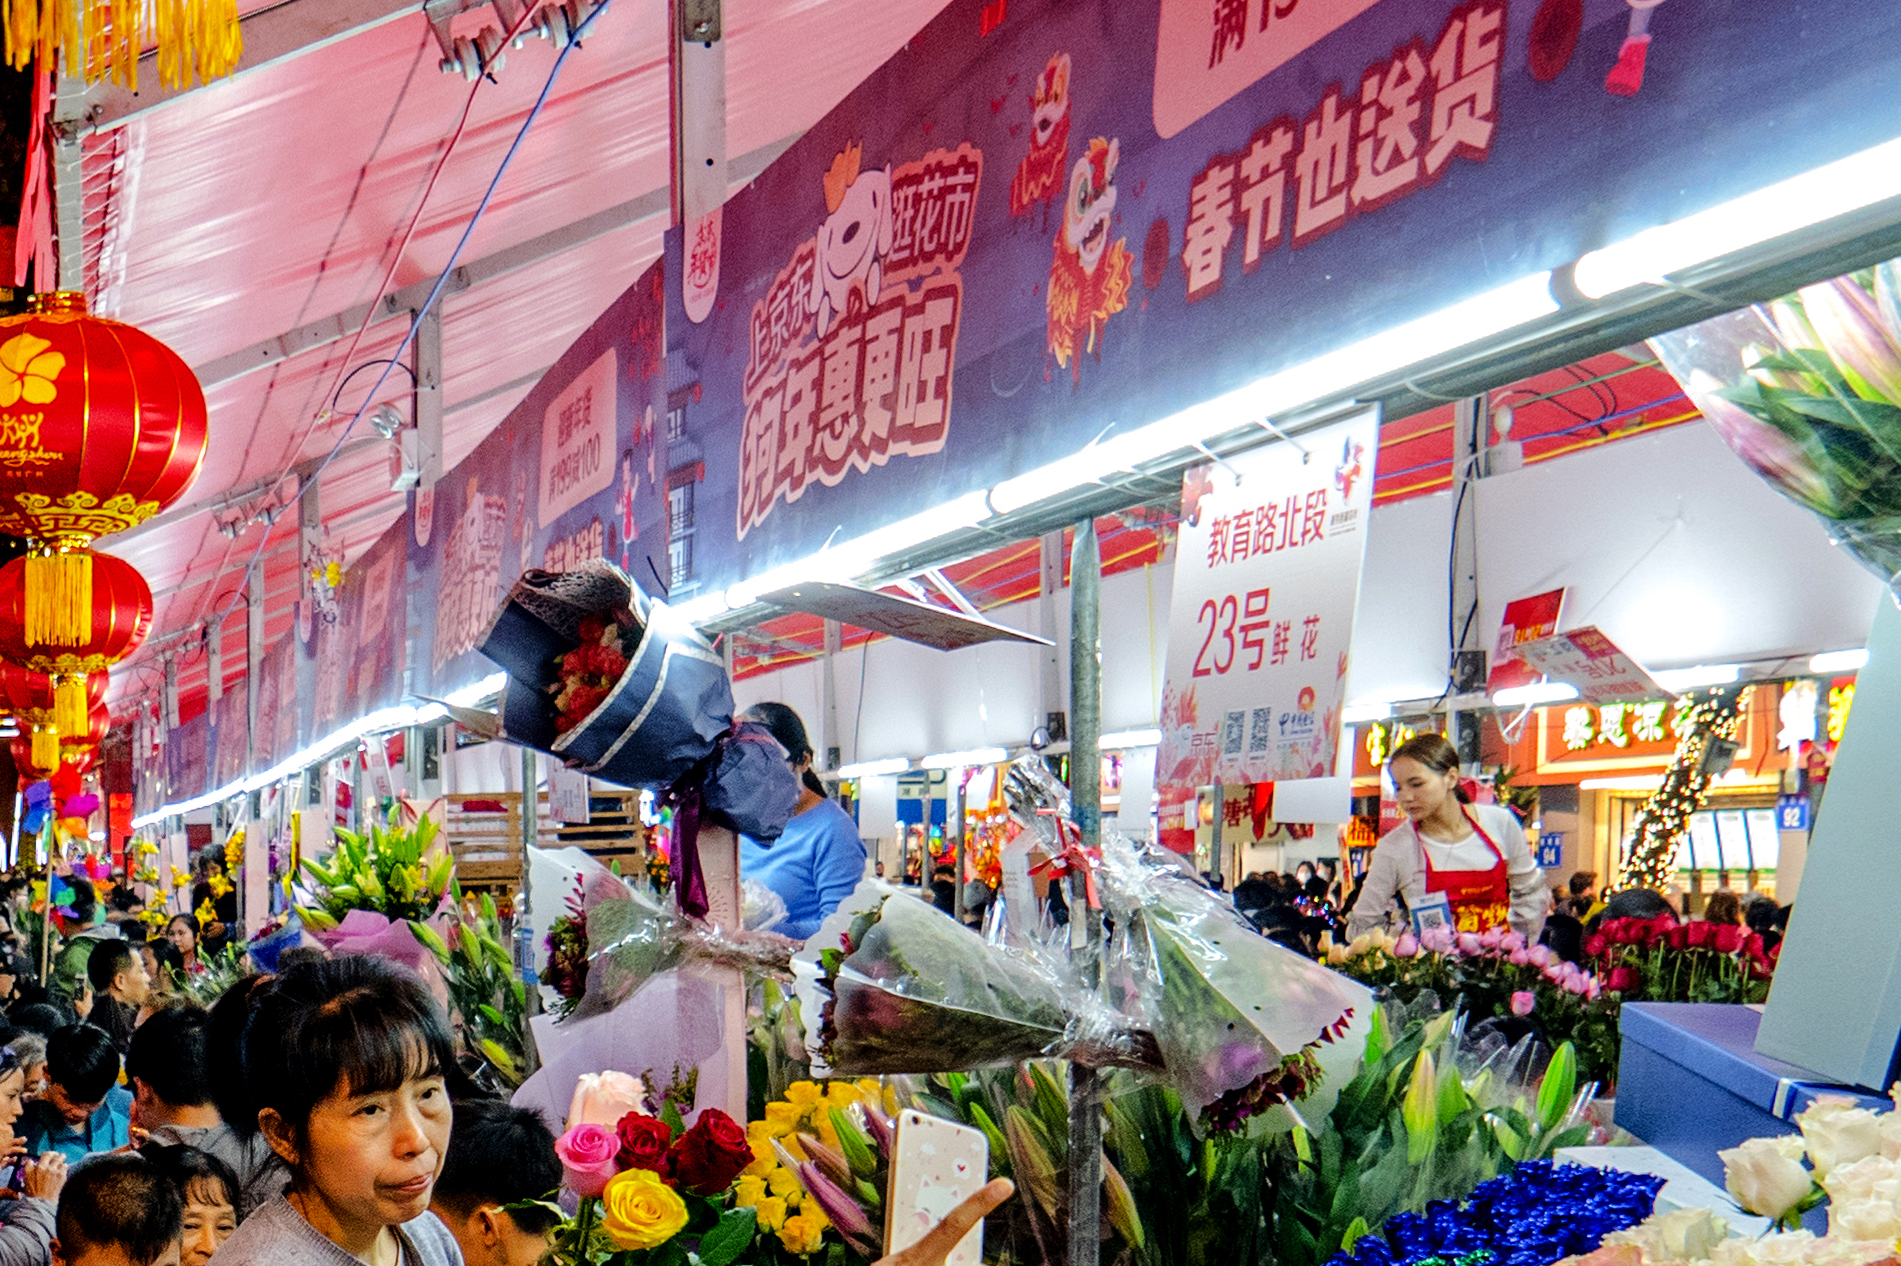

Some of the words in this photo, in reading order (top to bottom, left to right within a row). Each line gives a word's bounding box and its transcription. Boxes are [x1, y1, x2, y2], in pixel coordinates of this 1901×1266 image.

[1183, 8, 1501, 293] 春节也送货
[746, 256, 813, 386] 上京东
[886, 168, 976, 264] 逛花市
[742, 296, 956, 516] 狗年惠更旺
[1207, 487, 1328, 569] 教育路北段
[1191, 586, 1271, 678] 23号
[1270, 614, 1321, 666] 鲜花
[1783, 806, 1800, 827] 92
